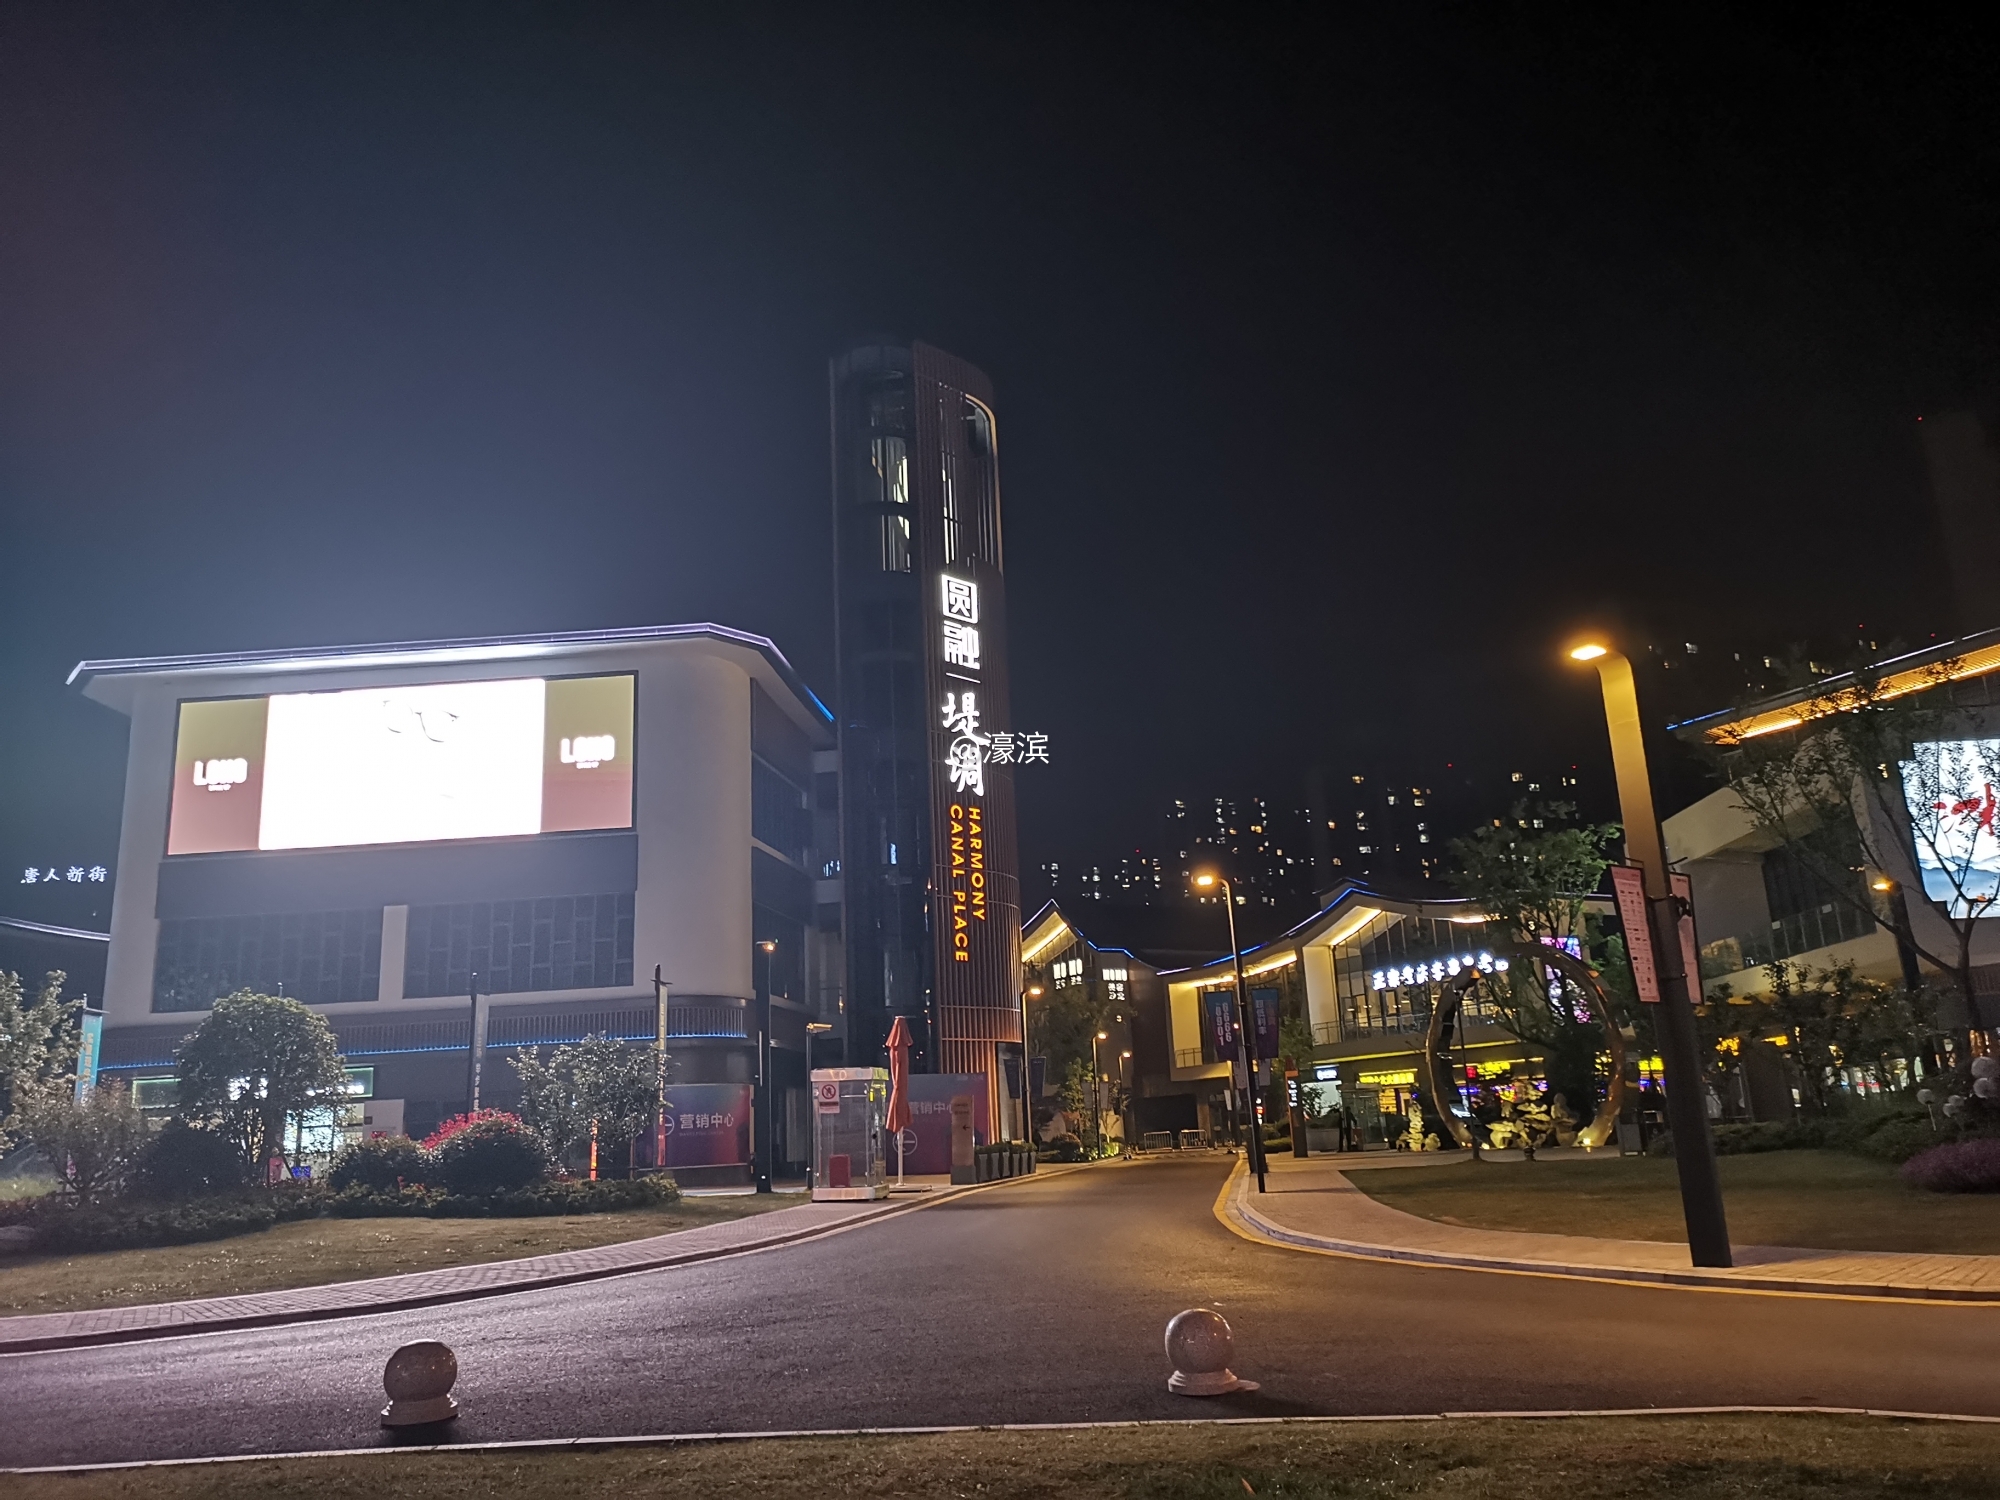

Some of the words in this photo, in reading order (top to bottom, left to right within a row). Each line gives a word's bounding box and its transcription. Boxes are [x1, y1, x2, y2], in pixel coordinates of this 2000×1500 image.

[941, 574, 981, 669] 圆融
[21, 866, 107, 884] 唐人新街
[950, 804, 965, 878] CANAL
[968, 807, 986, 921] HARMONY
[953, 891, 969, 962] PLACE
[679, 1112, 734, 1129] 营销中心
